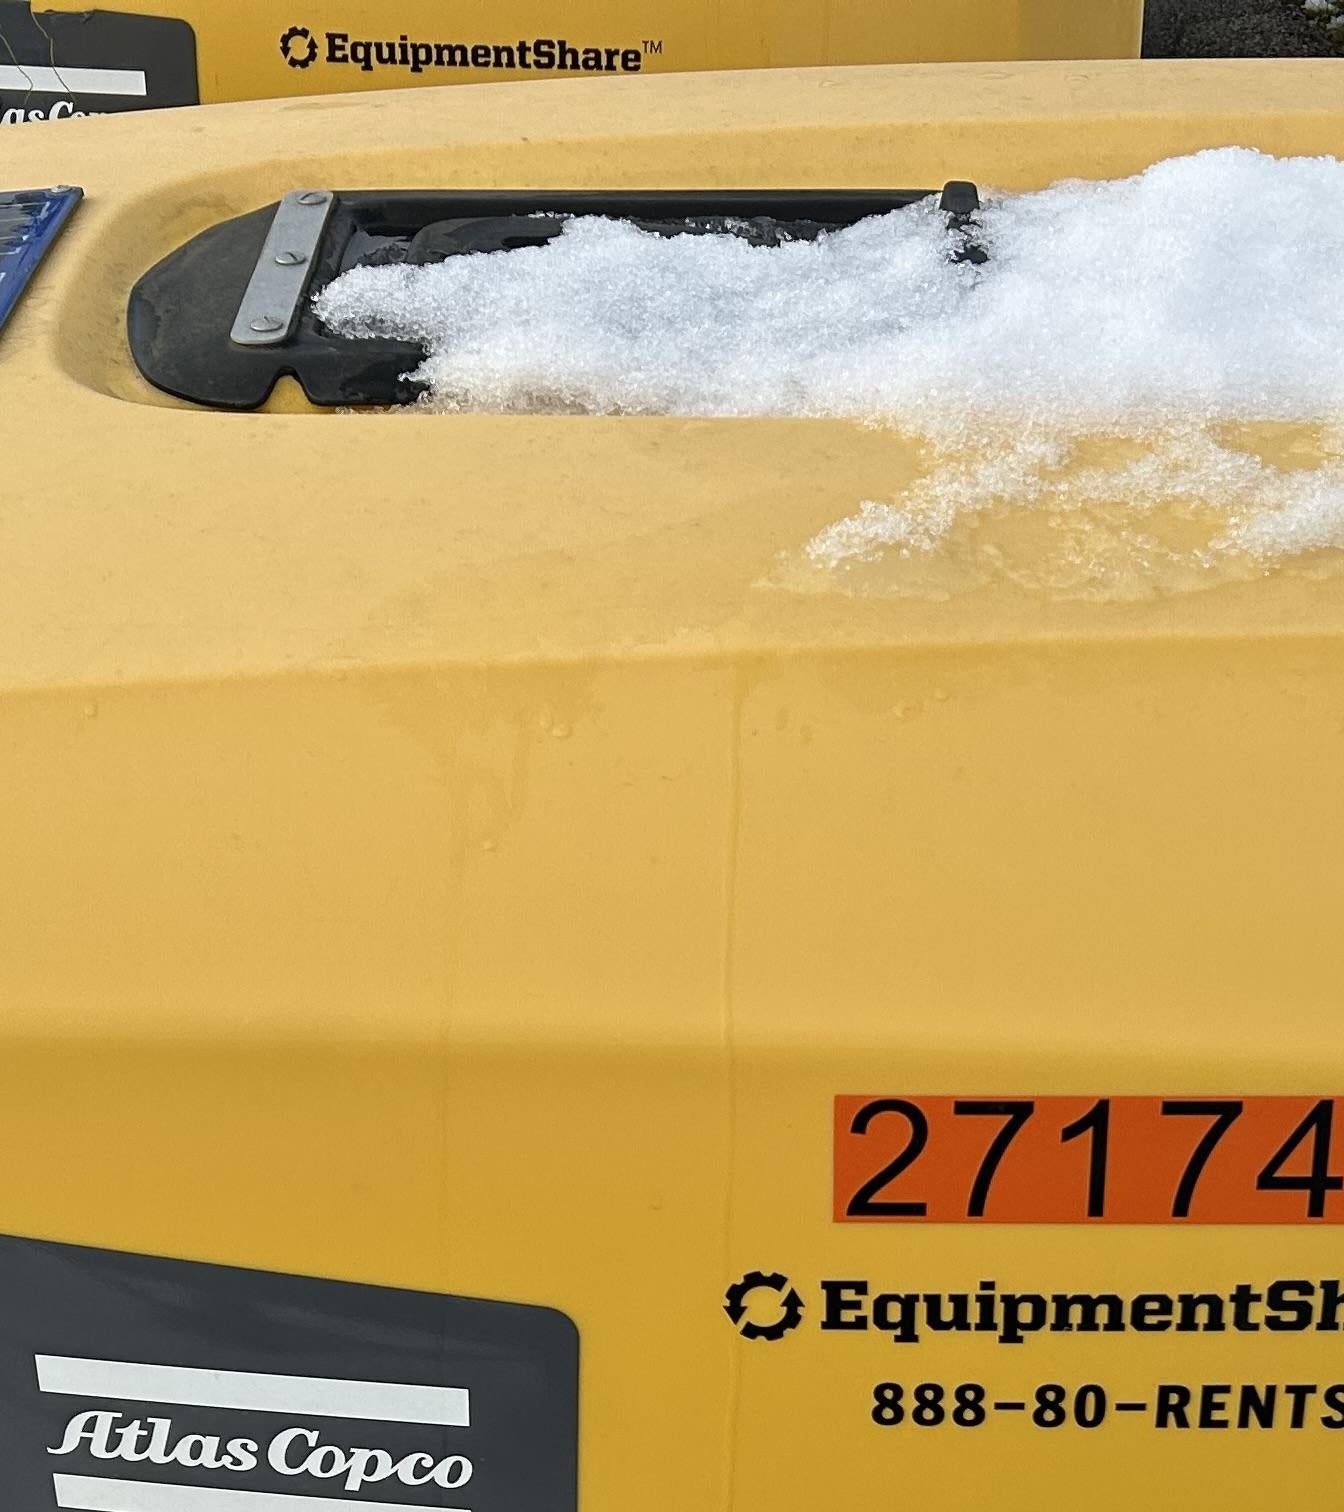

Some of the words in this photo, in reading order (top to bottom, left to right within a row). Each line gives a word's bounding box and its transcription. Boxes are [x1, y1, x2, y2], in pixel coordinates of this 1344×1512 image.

[325, 32, 641, 73] EquipmentShare
[46, 1409, 259, 1472] Atlas
[267, 1426, 475, 1491] Copco
